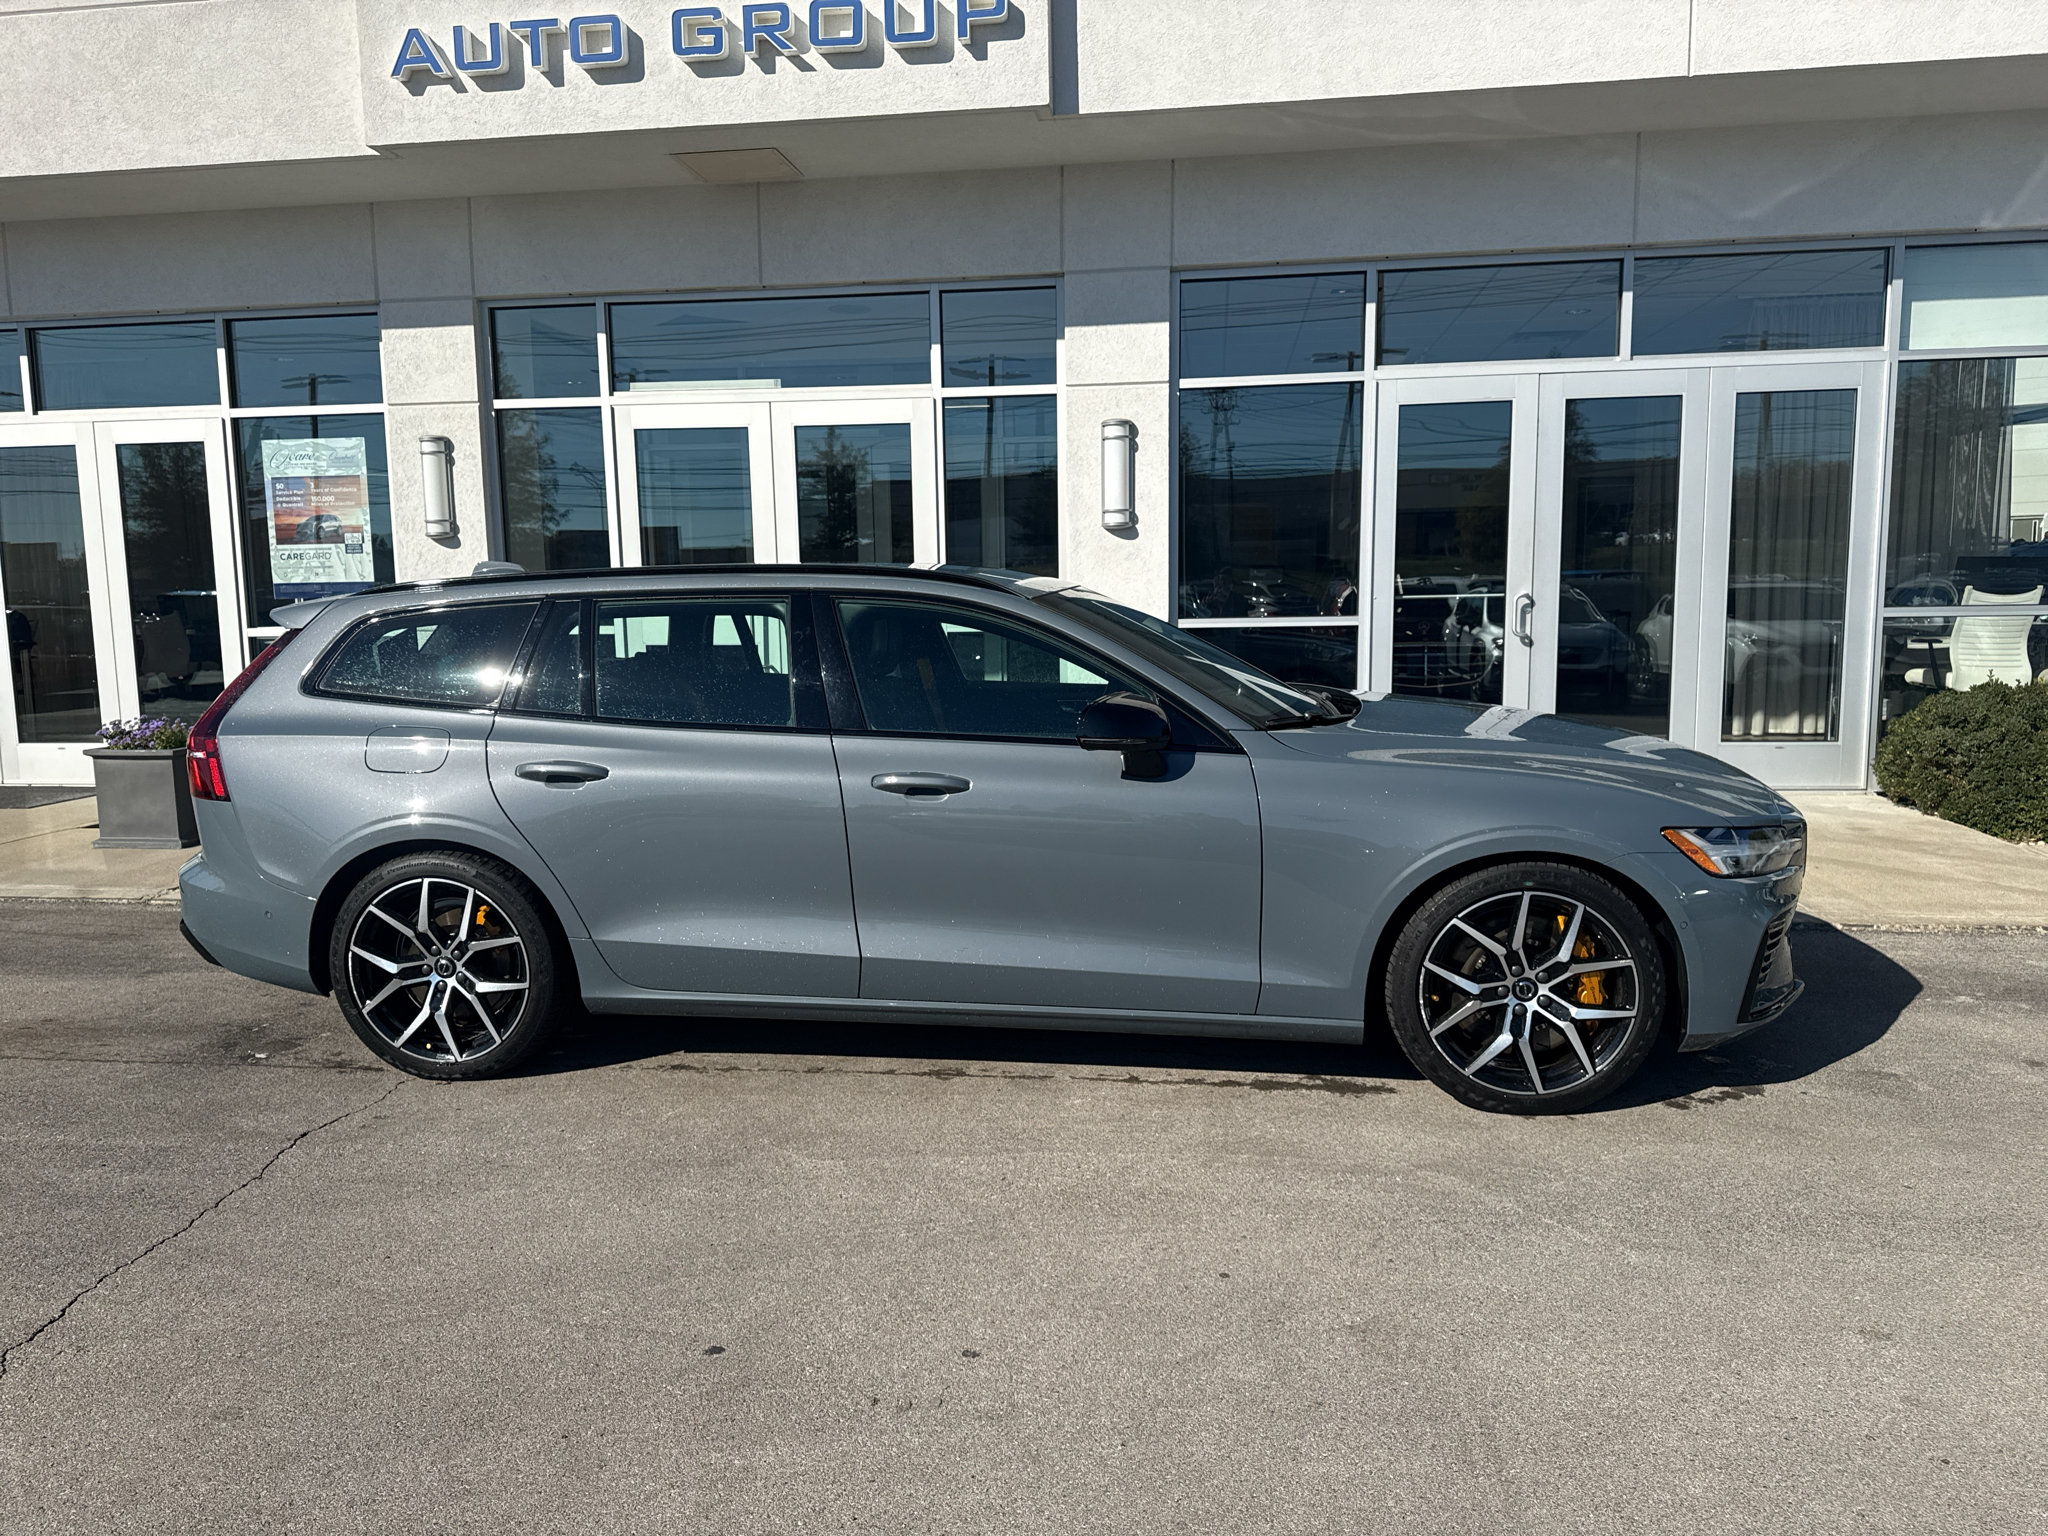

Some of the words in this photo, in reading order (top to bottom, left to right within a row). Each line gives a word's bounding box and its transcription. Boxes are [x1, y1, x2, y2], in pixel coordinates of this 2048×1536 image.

[391, 14, 628, 79] AUTO
[672, 0, 1009, 60] GROUP
[280, 552, 332, 560] CAREGARD
